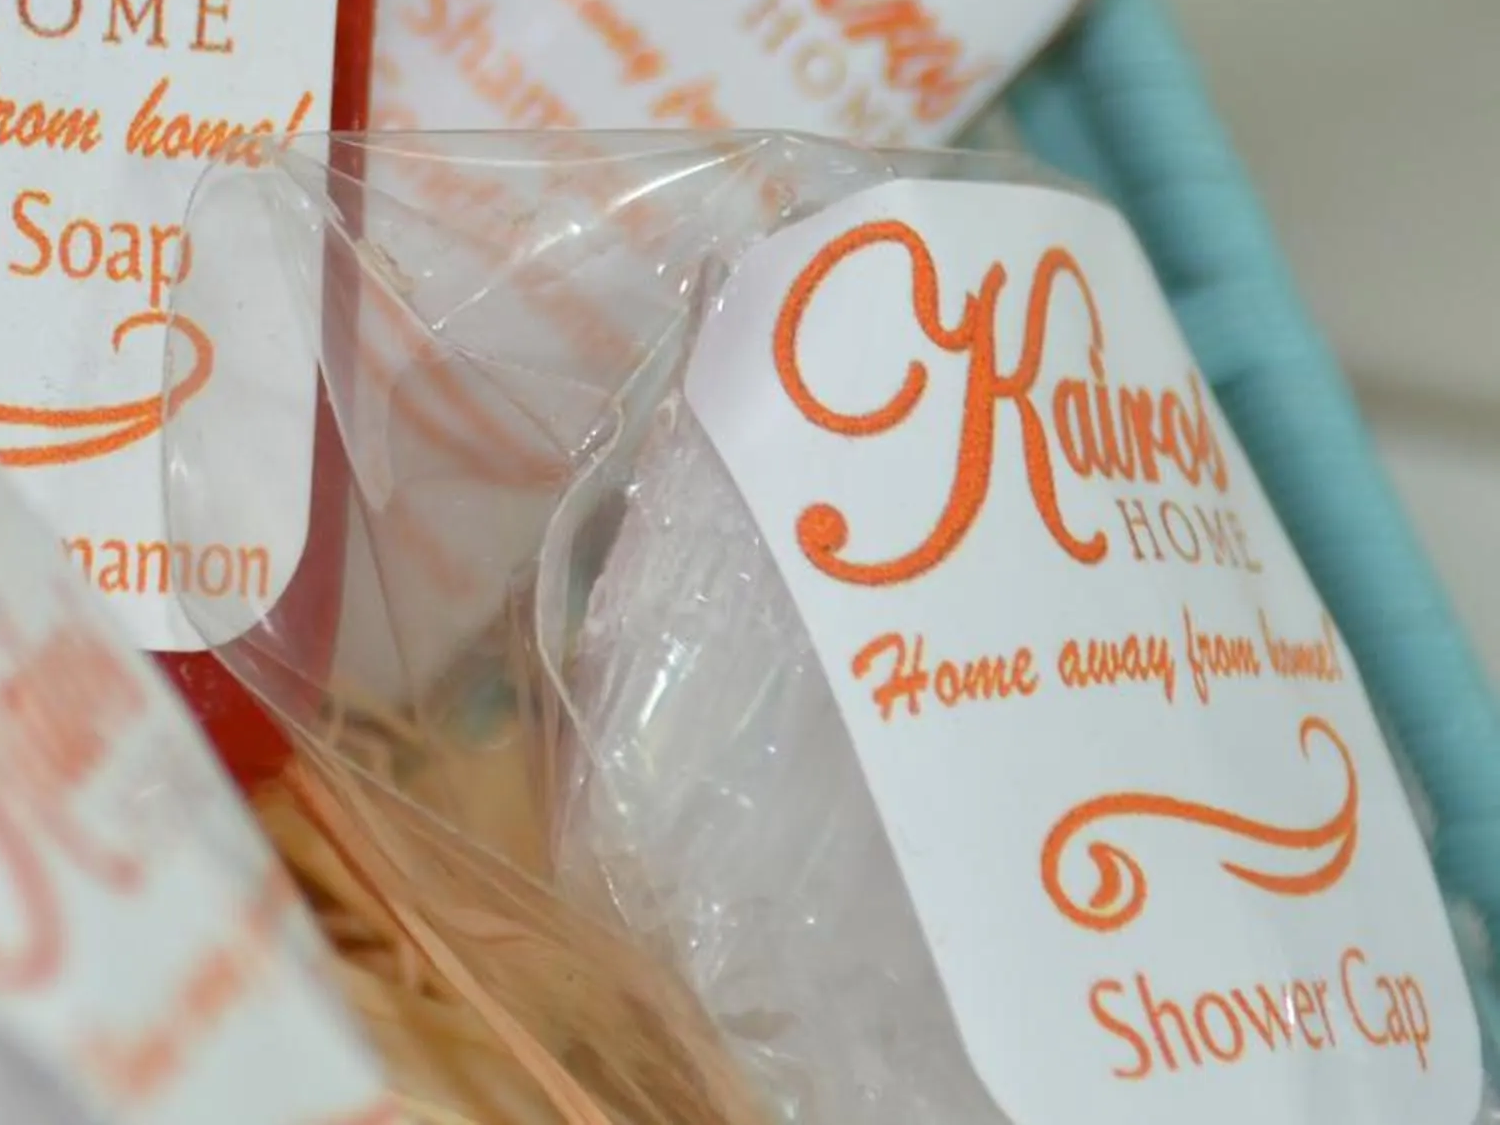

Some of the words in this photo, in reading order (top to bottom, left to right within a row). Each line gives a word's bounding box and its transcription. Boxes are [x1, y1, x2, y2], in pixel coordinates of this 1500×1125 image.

[125, 74, 314, 170] home!
[8, 188, 194, 309] Soap
[772, 218, 1229, 587] Kairos
[60, 534, 269, 600] namon
[1114, 496, 1264, 575] HOME
[850, 631, 1039, 723] Home
[1058, 632, 1178, 705] away
[1181, 603, 1260, 706] from
[1087, 970, 1337, 1081] Shower
[1339, 946, 1432, 1072] Cap
